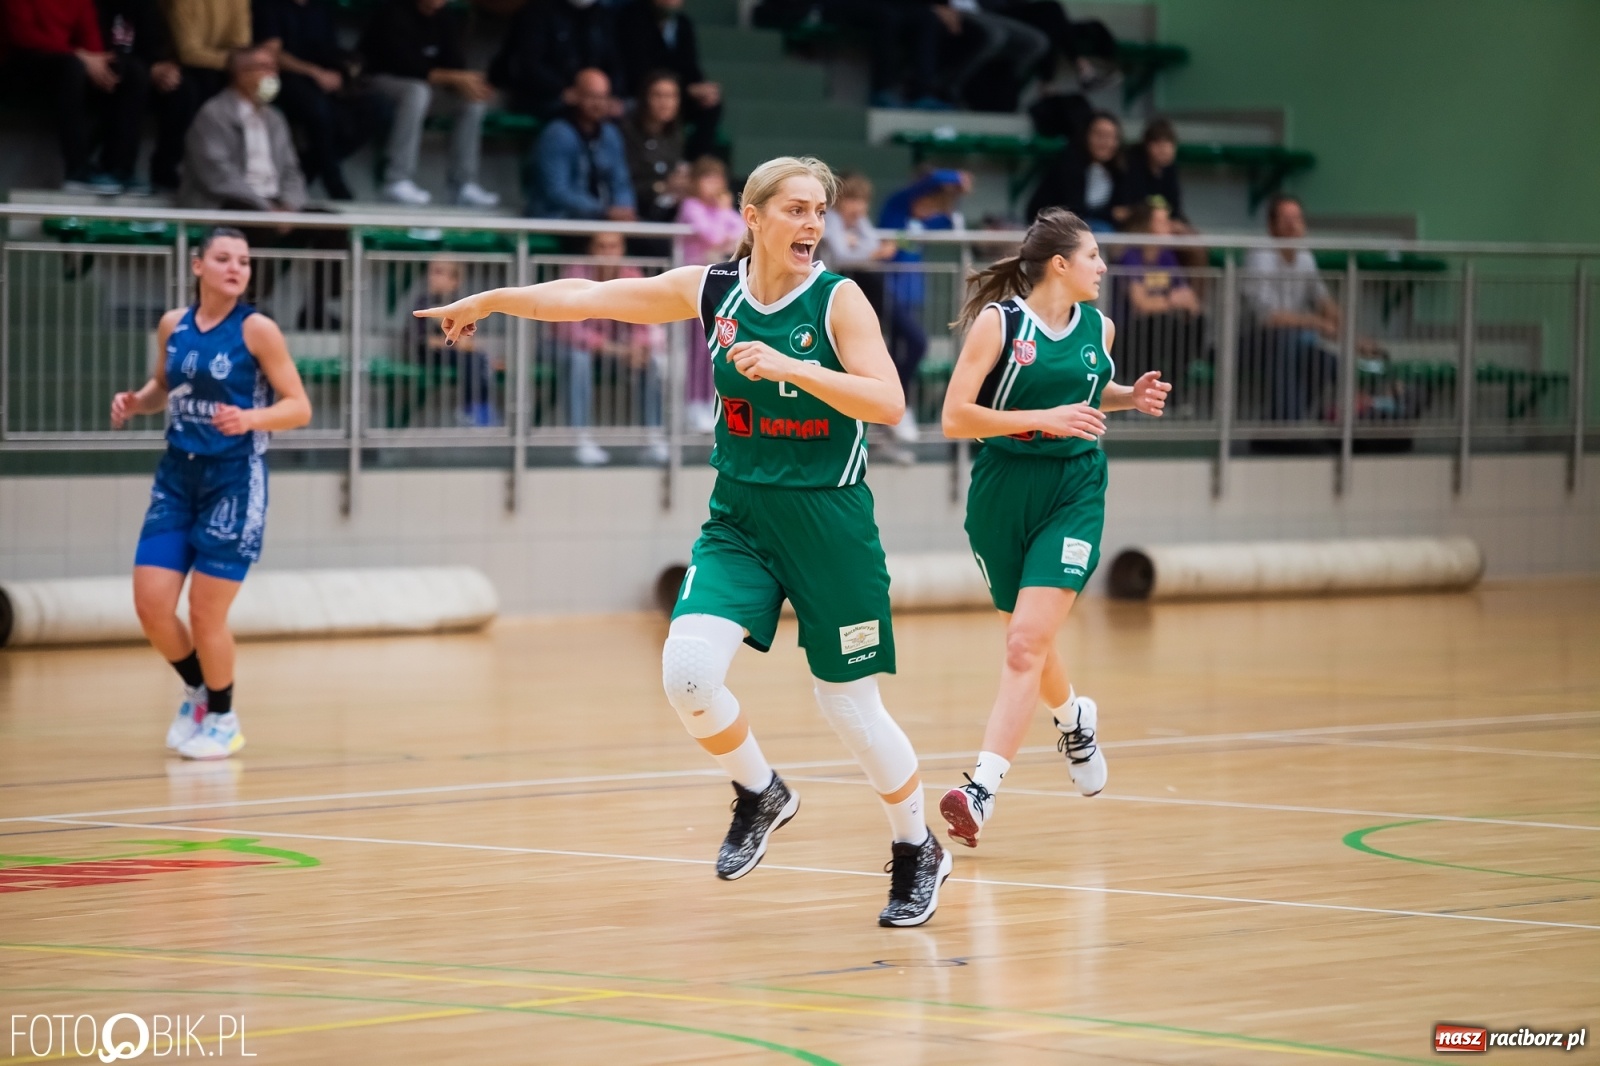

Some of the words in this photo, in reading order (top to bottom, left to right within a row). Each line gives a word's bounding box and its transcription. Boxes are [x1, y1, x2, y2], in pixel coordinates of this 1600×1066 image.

[181, 350, 199, 379] 4
[1086, 373, 1099, 406] 7
[760, 417, 830, 439] KAMAN
[848, 651, 877, 664] COLO
